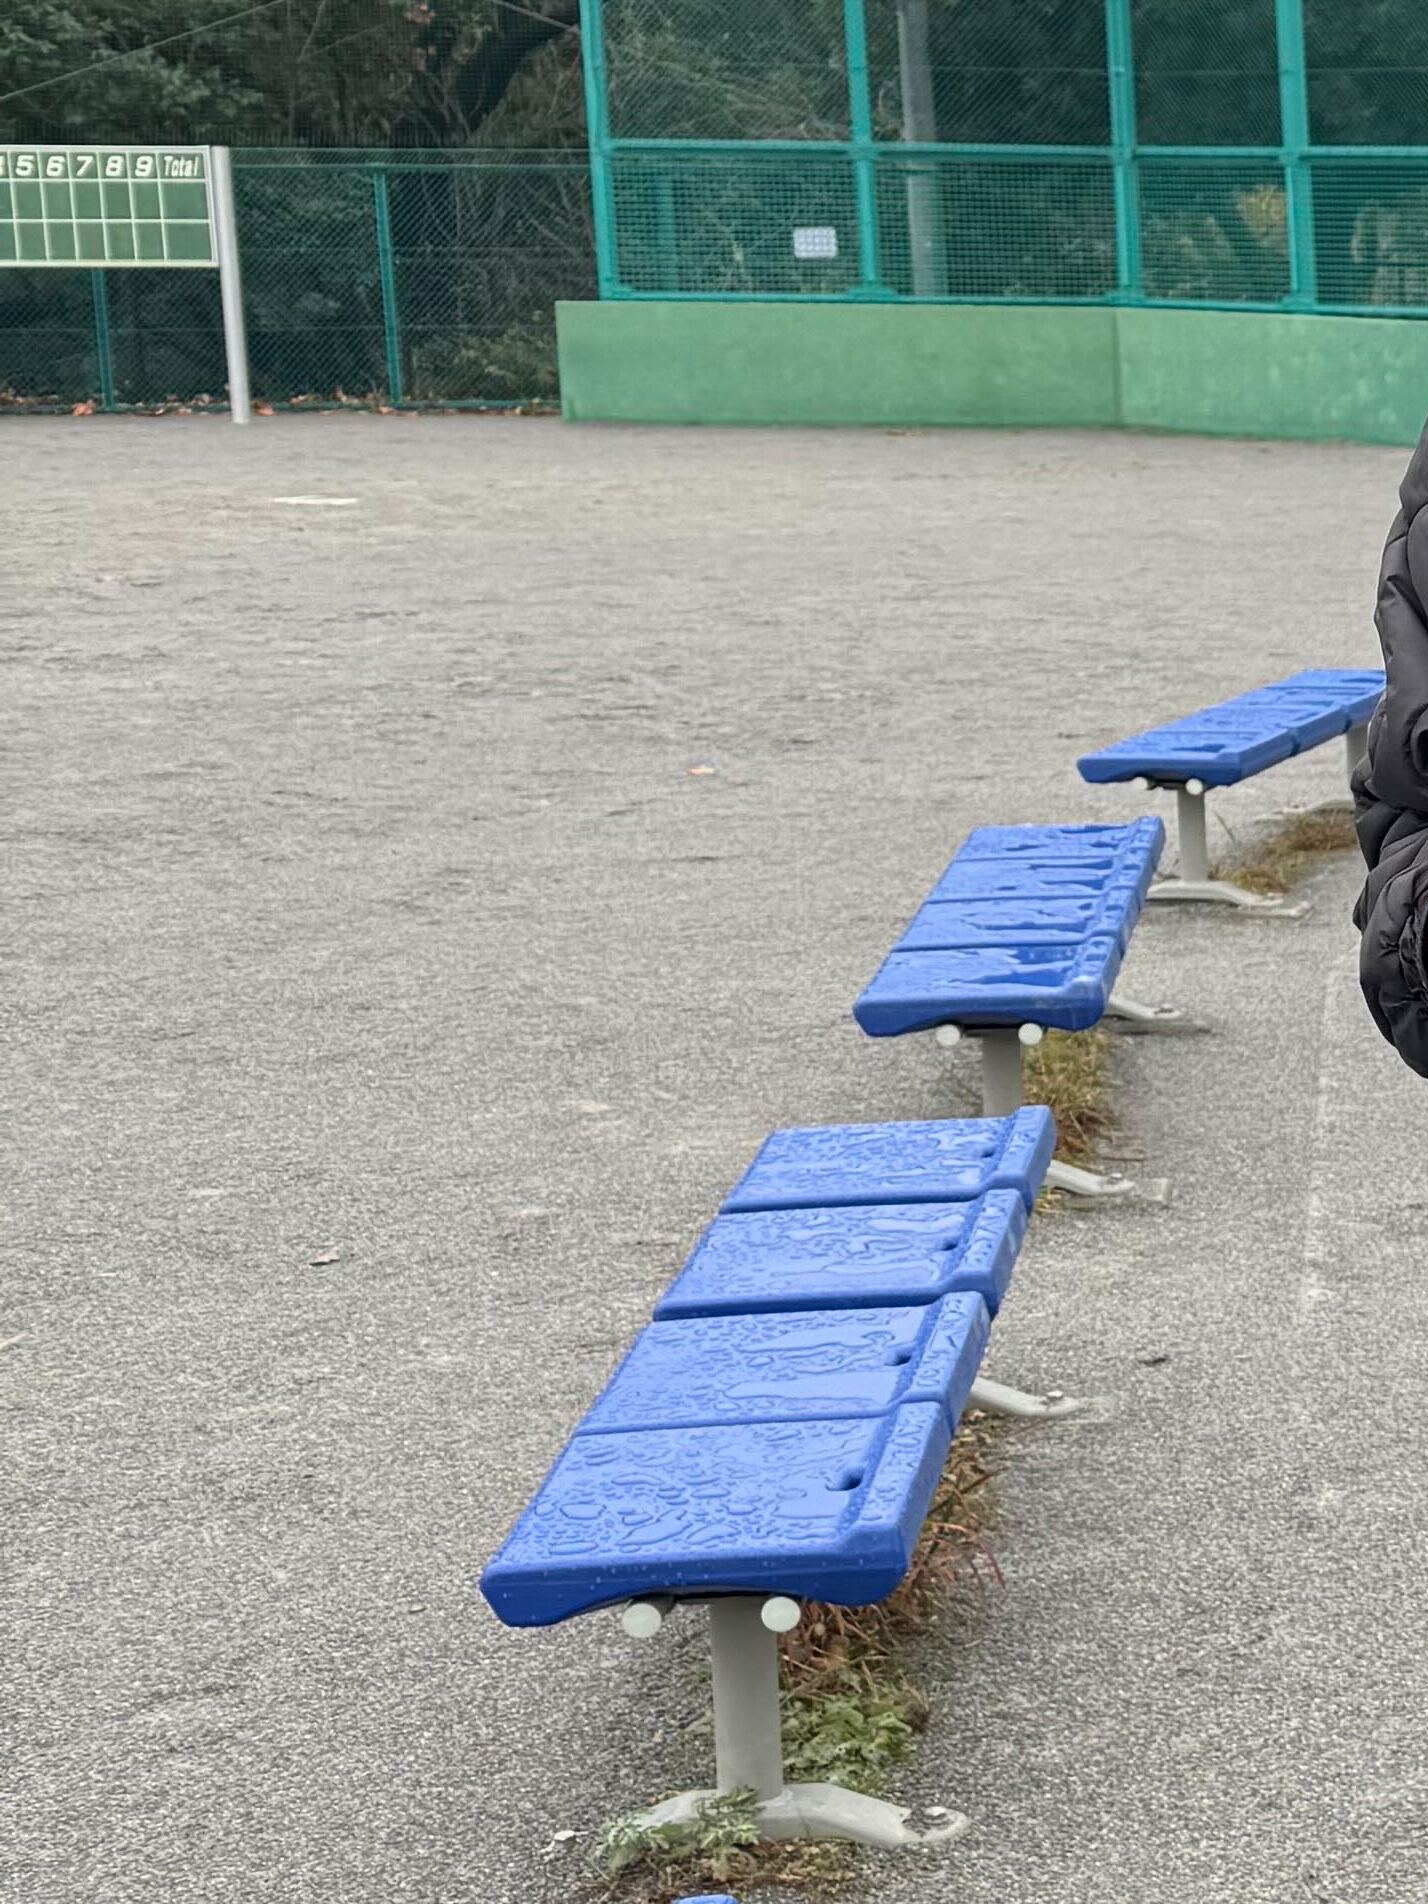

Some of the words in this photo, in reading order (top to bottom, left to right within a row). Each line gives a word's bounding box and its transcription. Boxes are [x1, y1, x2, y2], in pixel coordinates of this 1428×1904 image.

[15, 155, 34, 177] 5
[46, 155, 66, 177] 6
[76, 155, 94, 177] 7
[105, 155, 124, 177] 8
[135, 155, 154, 177] 9
[164, 155, 199, 177] Total
